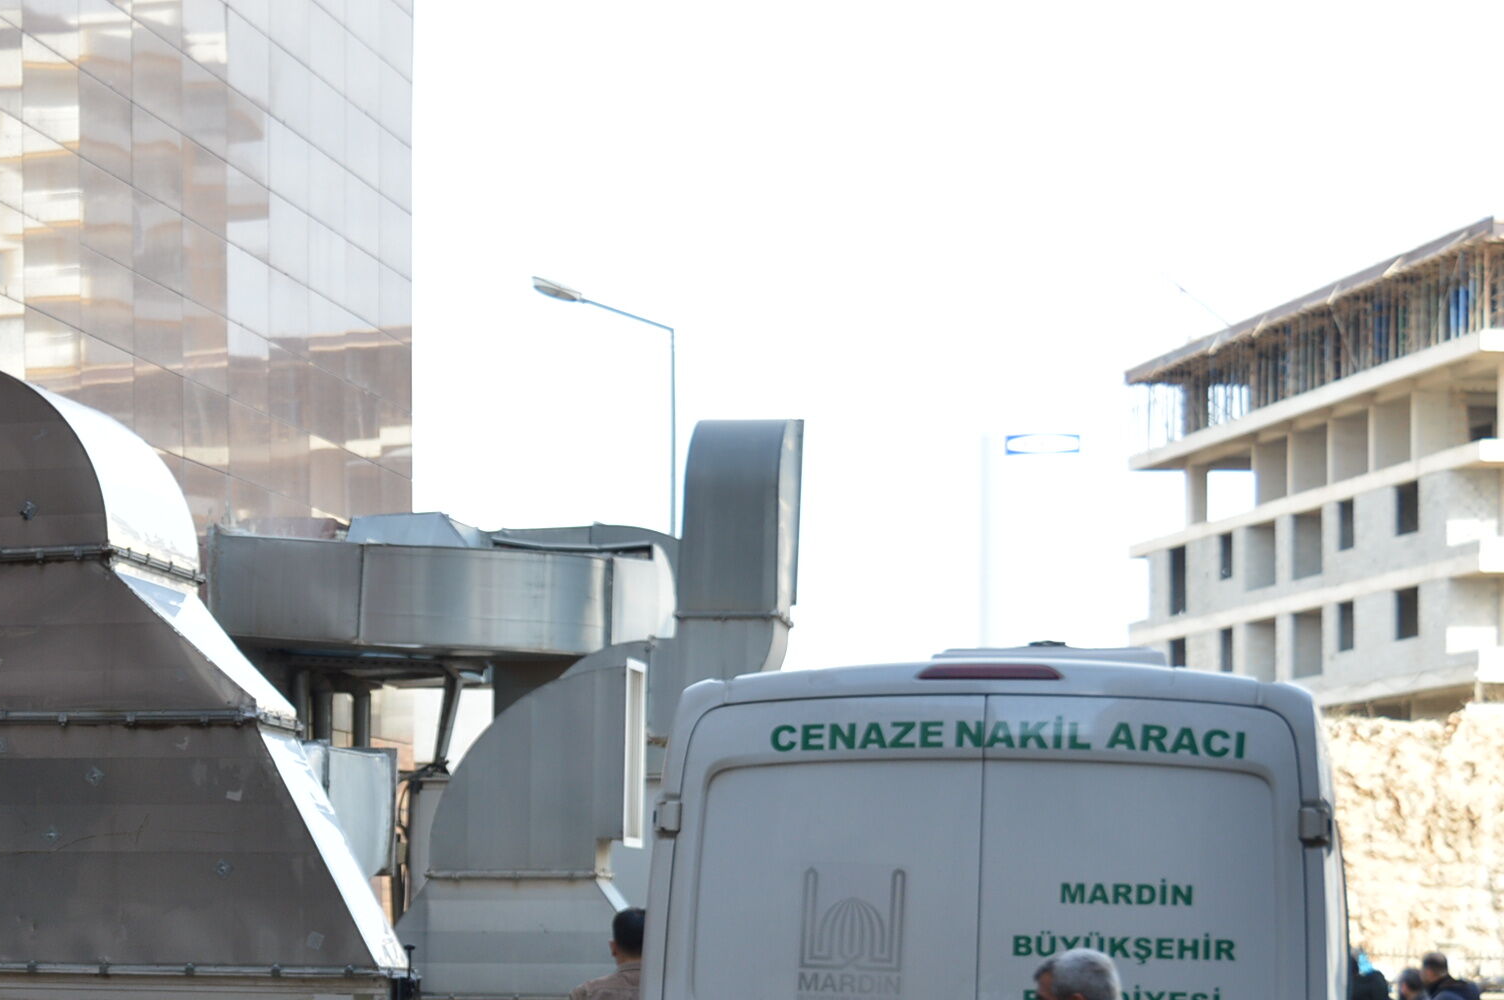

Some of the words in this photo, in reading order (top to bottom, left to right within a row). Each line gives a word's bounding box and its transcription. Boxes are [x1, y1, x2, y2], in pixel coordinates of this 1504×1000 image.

[769, 720, 944, 752] CENAZE
[954, 715, 1092, 750] NAKİL
[1105, 721, 1246, 759] ARACI
[1059, 878, 1194, 906] MARDİN
[1011, 930, 1236, 965] BÜYÜKŞEHİR
